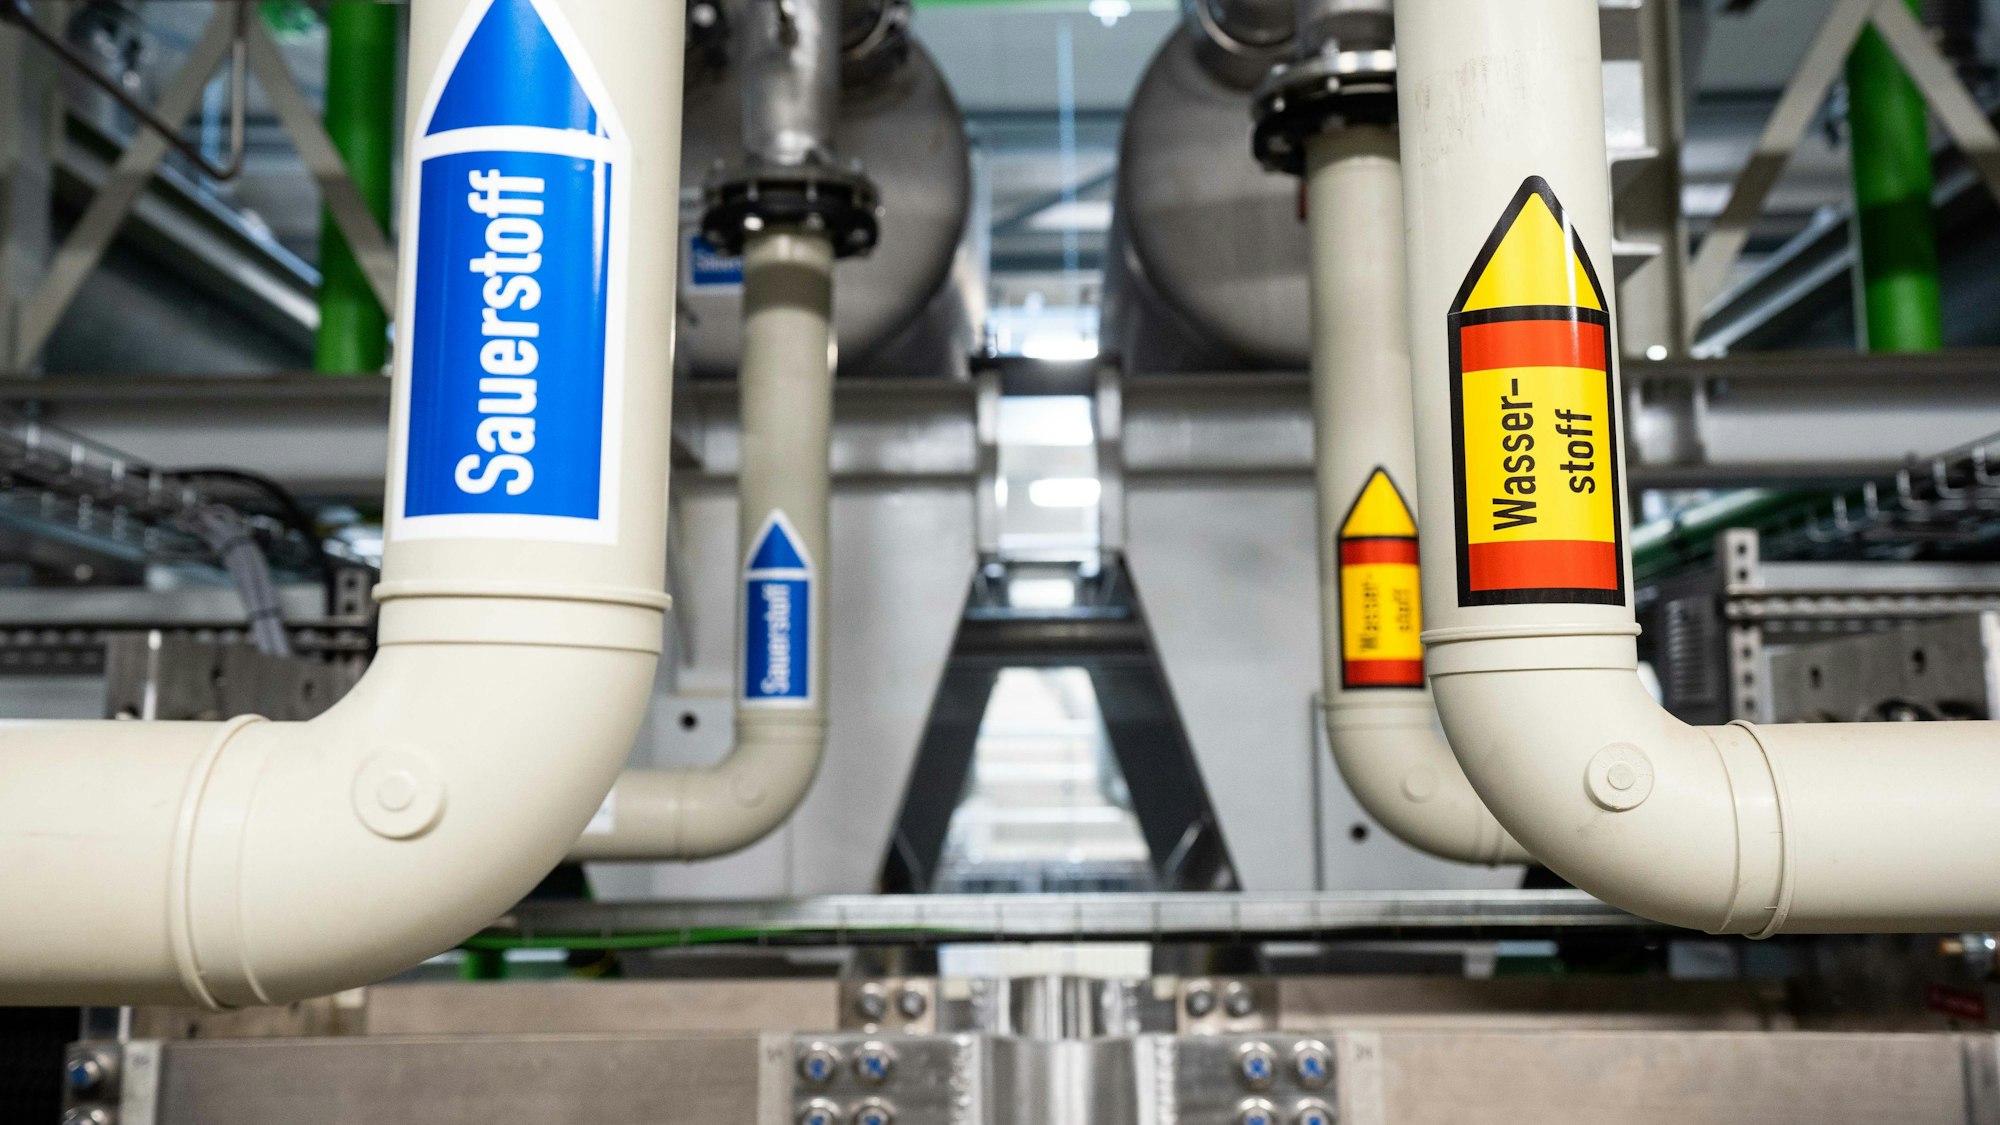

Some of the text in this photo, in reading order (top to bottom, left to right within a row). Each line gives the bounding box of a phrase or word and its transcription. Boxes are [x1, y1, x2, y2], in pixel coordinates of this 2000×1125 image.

[454, 168, 546, 496] Sauerstoff
[1492, 378, 1538, 531] Wasser-
[1554, 408, 1596, 494] stoff
[761, 583, 791, 694] Sauerstoff
